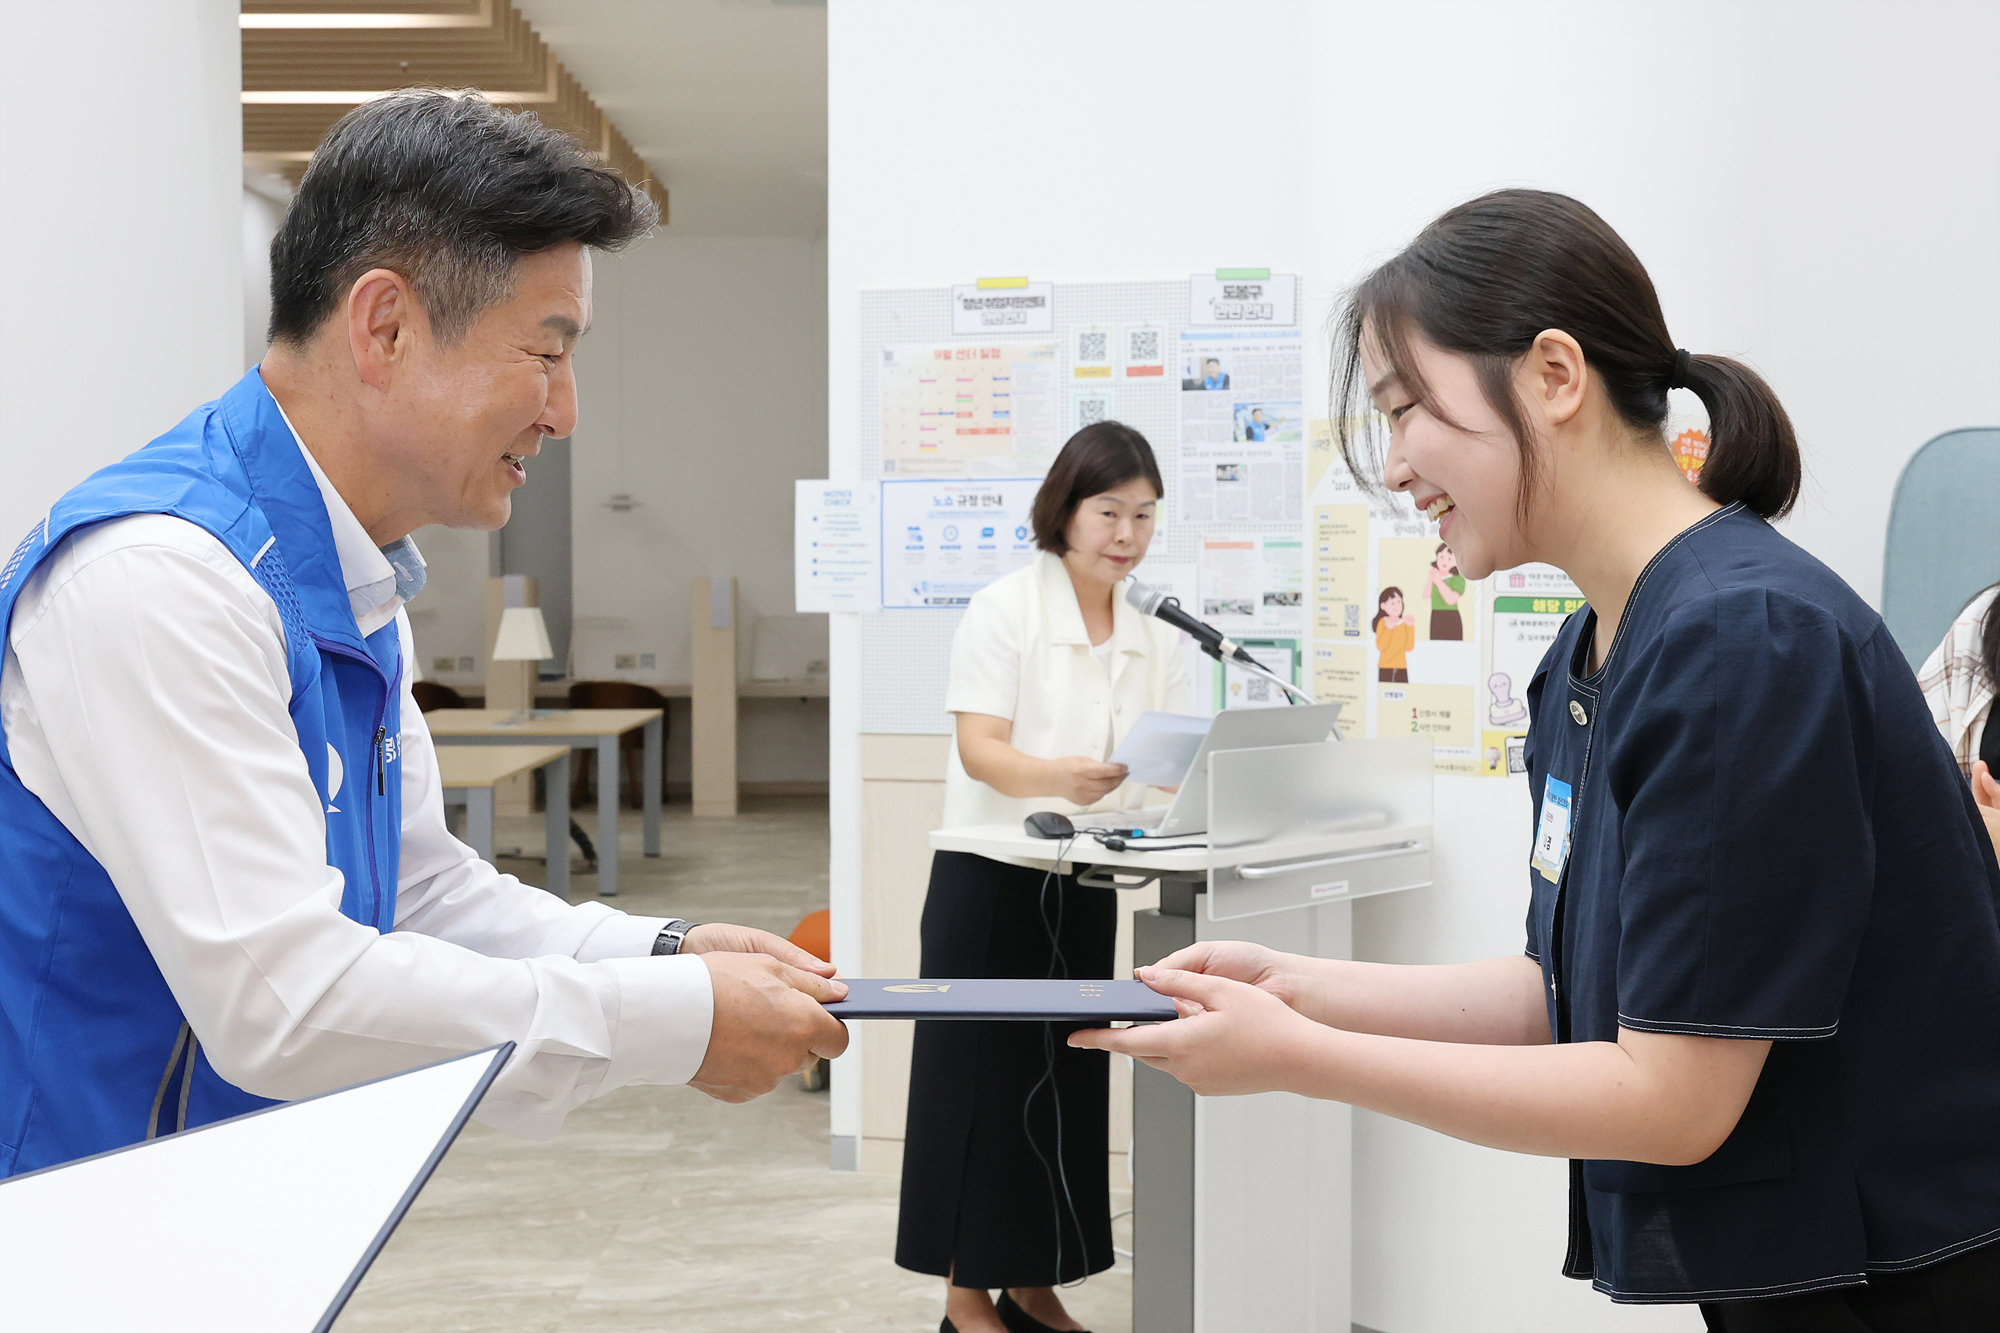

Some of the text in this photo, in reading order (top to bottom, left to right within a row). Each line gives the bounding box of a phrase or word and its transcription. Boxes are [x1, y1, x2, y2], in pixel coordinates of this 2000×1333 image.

[1223, 285, 1263, 300] 도봉구
[1214, 303, 1273, 320] 관련 안내
[934, 347, 1001, 361] 9월 센터 일정
[823, 490, 852, 498] NOTICE
[933, 494, 1003, 507] 노쇼 규정 안내
[1532, 598, 1586, 613] 해당 인
[1411, 707, 1418, 719] 1
[1411, 721, 1418, 732] 2
